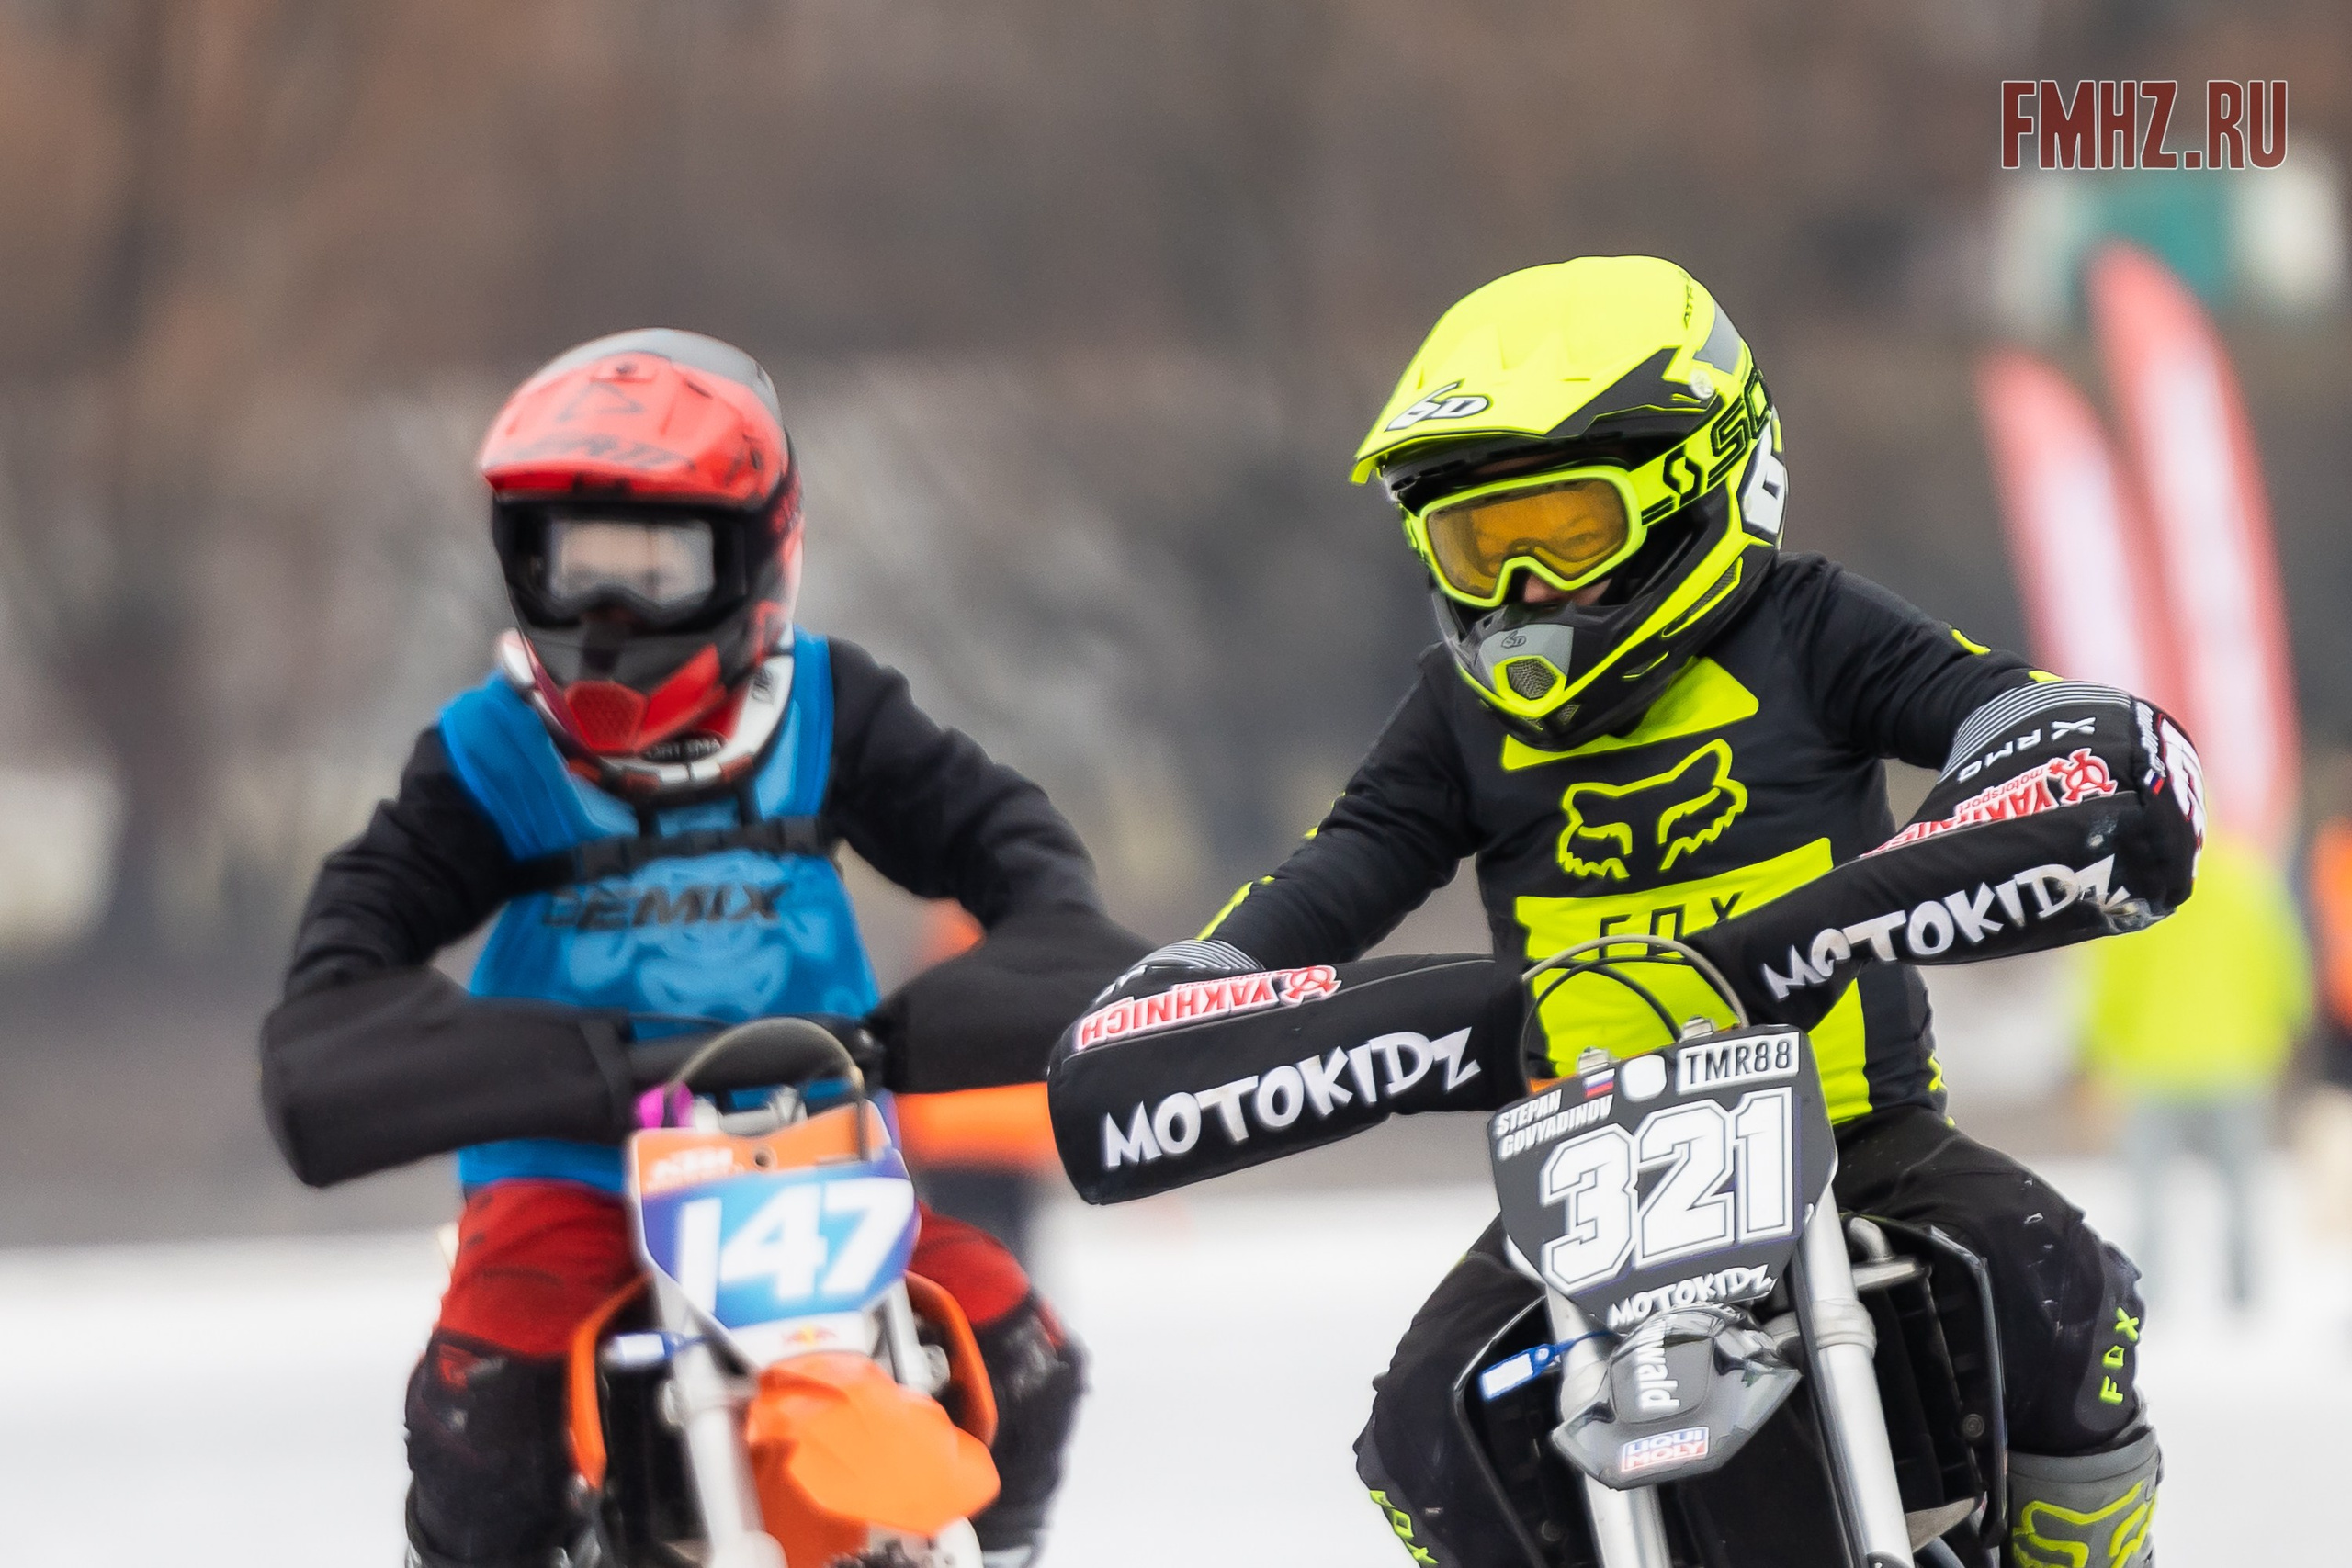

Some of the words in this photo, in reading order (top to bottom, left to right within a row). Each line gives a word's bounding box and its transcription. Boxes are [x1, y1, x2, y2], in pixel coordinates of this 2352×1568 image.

[1384, 378, 1492, 432] 6D
[1501, 629, 1527, 649] 6D
[1959, 764, 2045, 815] motorsport
[1761, 853, 2132, 1001] MOTOKIDZ
[1082, 976, 1273, 1047] YAKHNICH
[1685, 1039, 1794, 1086] TMR88
[1105, 1026, 1481, 1168] MOTOKIDZ
[1495, 1089, 1562, 1137] STEPAN
[1498, 1094, 1614, 1160] GOVYADINOV
[1540, 1087, 1794, 1294] 321
[675, 1177, 913, 1317] 147
[1609, 1264, 1773, 1328] MOTOKIDZ
[2099, 1306, 2140, 1405] FOX
[1624, 1429, 1704, 1456] LIQUI
[1624, 1439, 1706, 1469] MOLY
